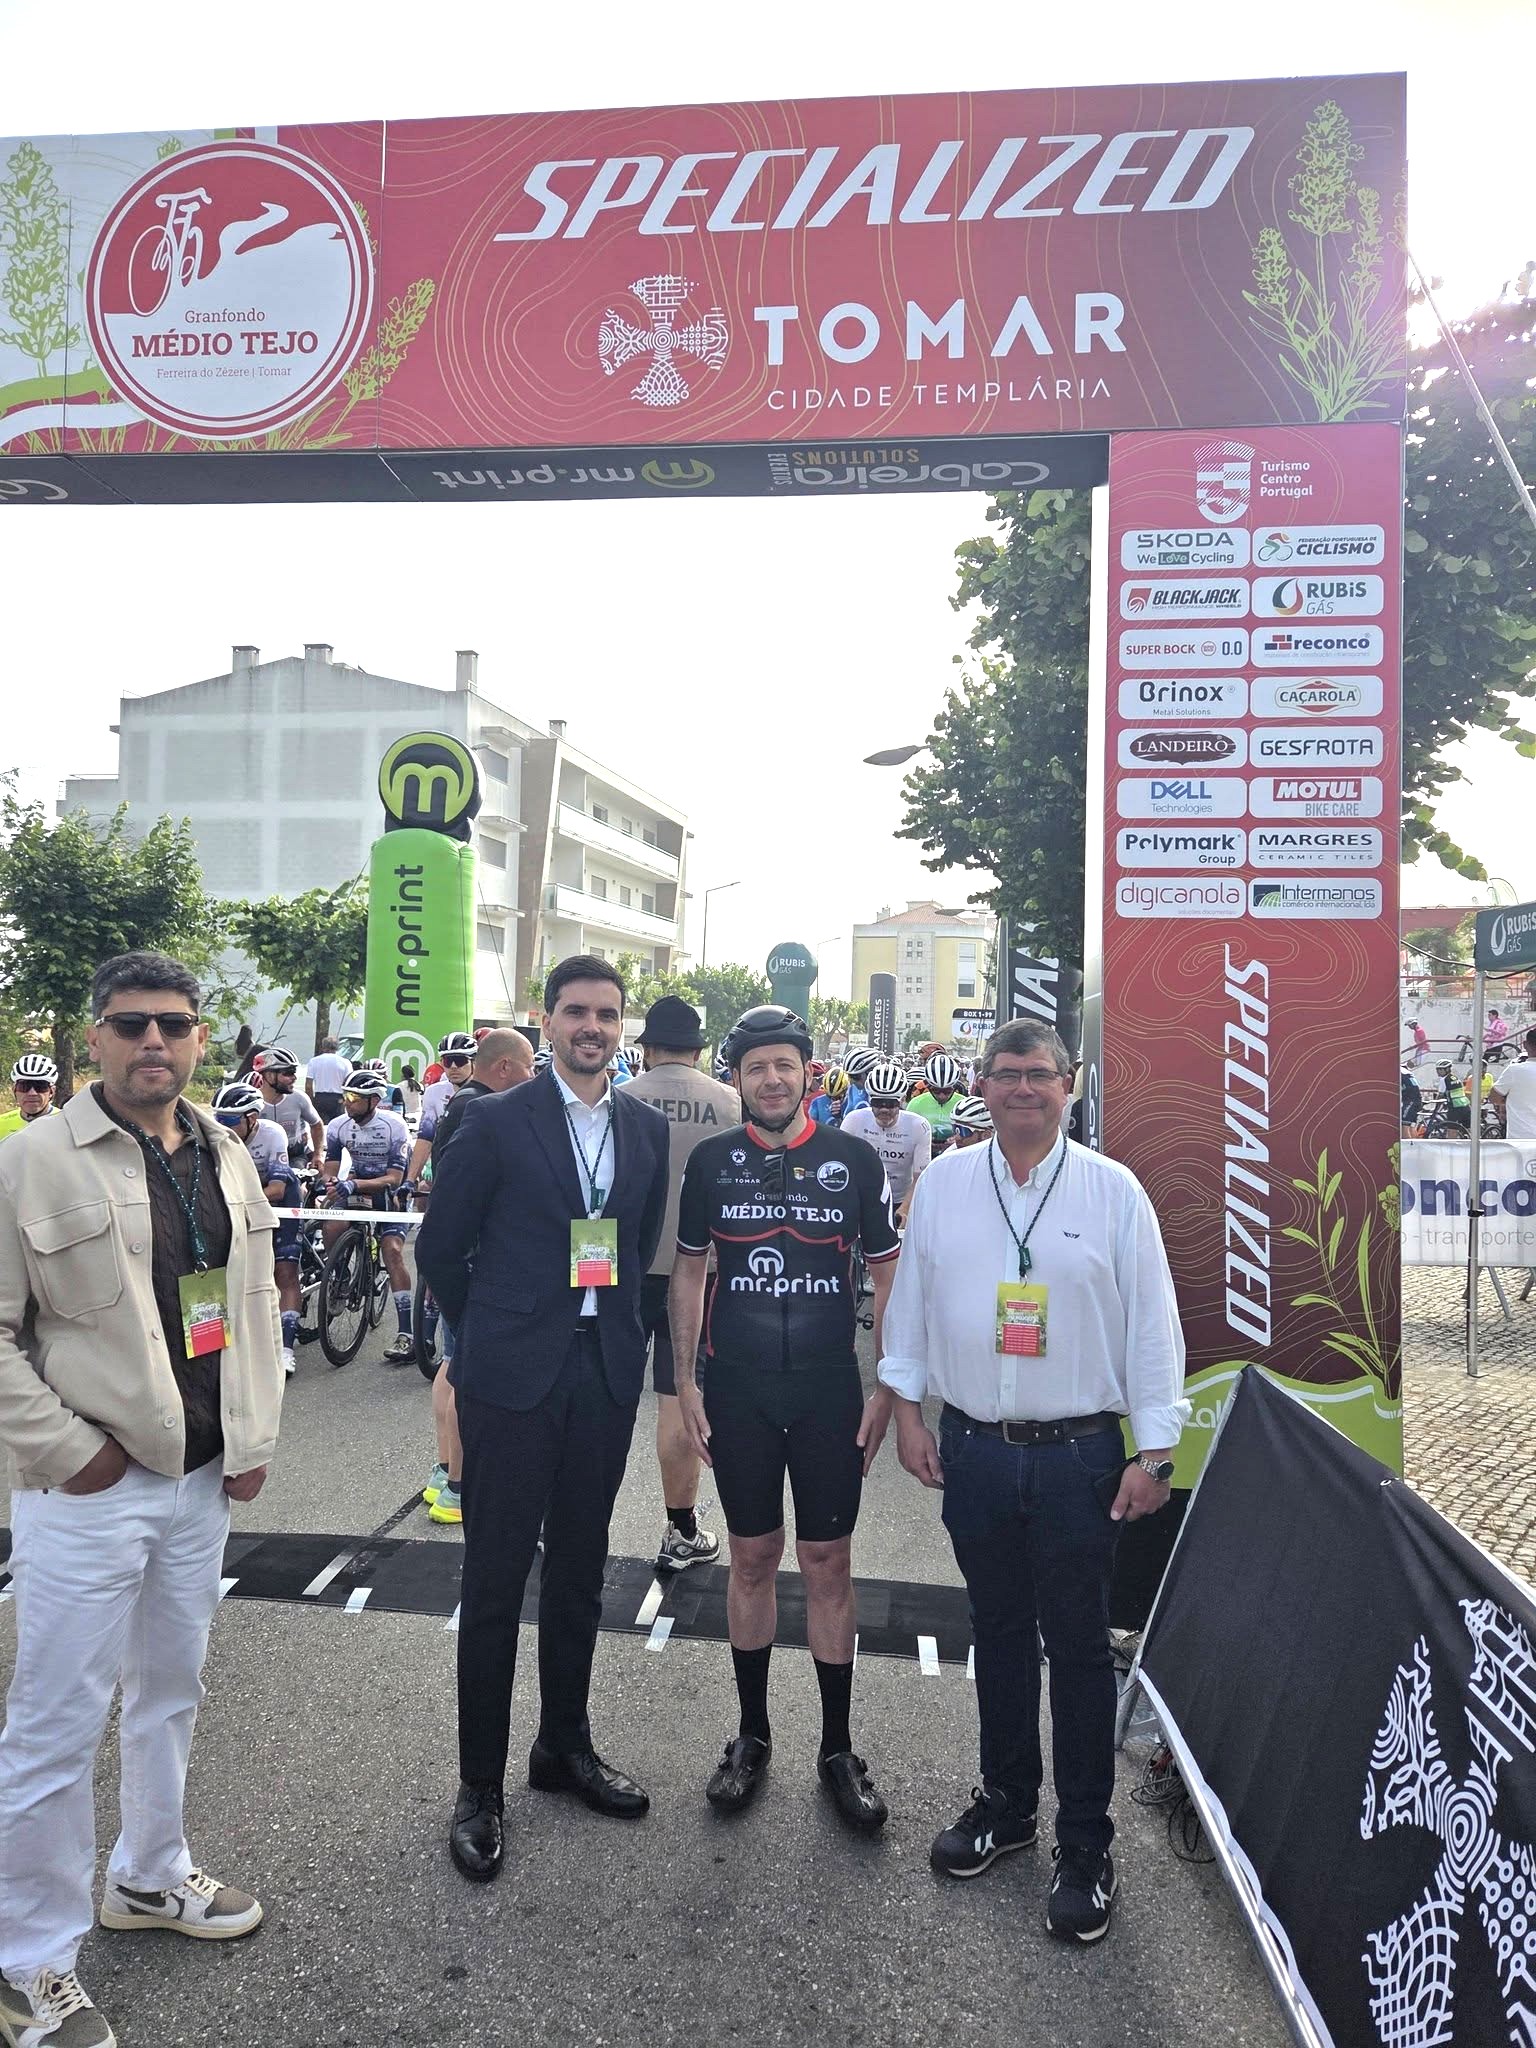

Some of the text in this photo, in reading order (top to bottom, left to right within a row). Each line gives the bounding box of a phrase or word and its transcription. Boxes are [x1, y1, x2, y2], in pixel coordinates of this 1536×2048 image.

[493, 126, 1256, 243] SPECIALIZED
[184, 308, 266, 324] Granfondo
[754, 292, 1126, 365] TOMAR
[131, 328, 319, 358] MÉDIO TEJO
[156, 365, 292, 379] Ferreira do Zêzere Tomar
[767, 375, 1112, 411] CIDADE TEMPLÁRIA
[792, 449, 920, 465] SOLUTIONS
[768, 452, 793, 486] EVENTOS
[1261, 460, 1310, 472] Turismo
[1260, 473, 1302, 485] Centro
[1260, 485, 1313, 499] Portugal
[1296, 542, 1375, 556] CICLISMO
[1137, 553, 1157, 565] We
[1191, 552, 1235, 566] Cycling
[1306, 600, 1335, 615] GÁS
[1126, 644, 1160, 655] SUPER
[1164, 643, 1196, 655] BOCK
[1221, 640, 1243, 656] 0.0
[1294, 638, 1370, 650] reconco
[1139, 681, 1224, 702] Brinox
[1279, 689, 1356, 705] CAÇAROLA
[1175, 708, 1211, 716] Solutions
[1137, 738, 1228, 754] LANDEIRO
[1260, 739, 1374, 756] GESFROTA
[1151, 780, 1212, 800] DELL
[1276, 781, 1358, 799] MOTUL
[1152, 803, 1213, 815] Technologies
[1305, 803, 1359, 816] BIKE CARE
[1125, 833, 1235, 853] Polymark
[1259, 834, 1373, 846] MARGRES
[1198, 854, 1236, 866] Group
[1121, 881, 1240, 911] digicanola
[1282, 884, 1376, 900] Intermanos
[1282, 900, 1314, 908] comércio
[1506, 934, 1522, 954] GÁS
[963, 1010, 978, 1018] BOX
[1224, 942, 1272, 1347] SPECIALIZED
[721, 1202, 844, 1223] MÉDIO TEJO
[1426, 1226, 1535, 1248] tranporte
[730, 1273, 840, 1298] mr.print
